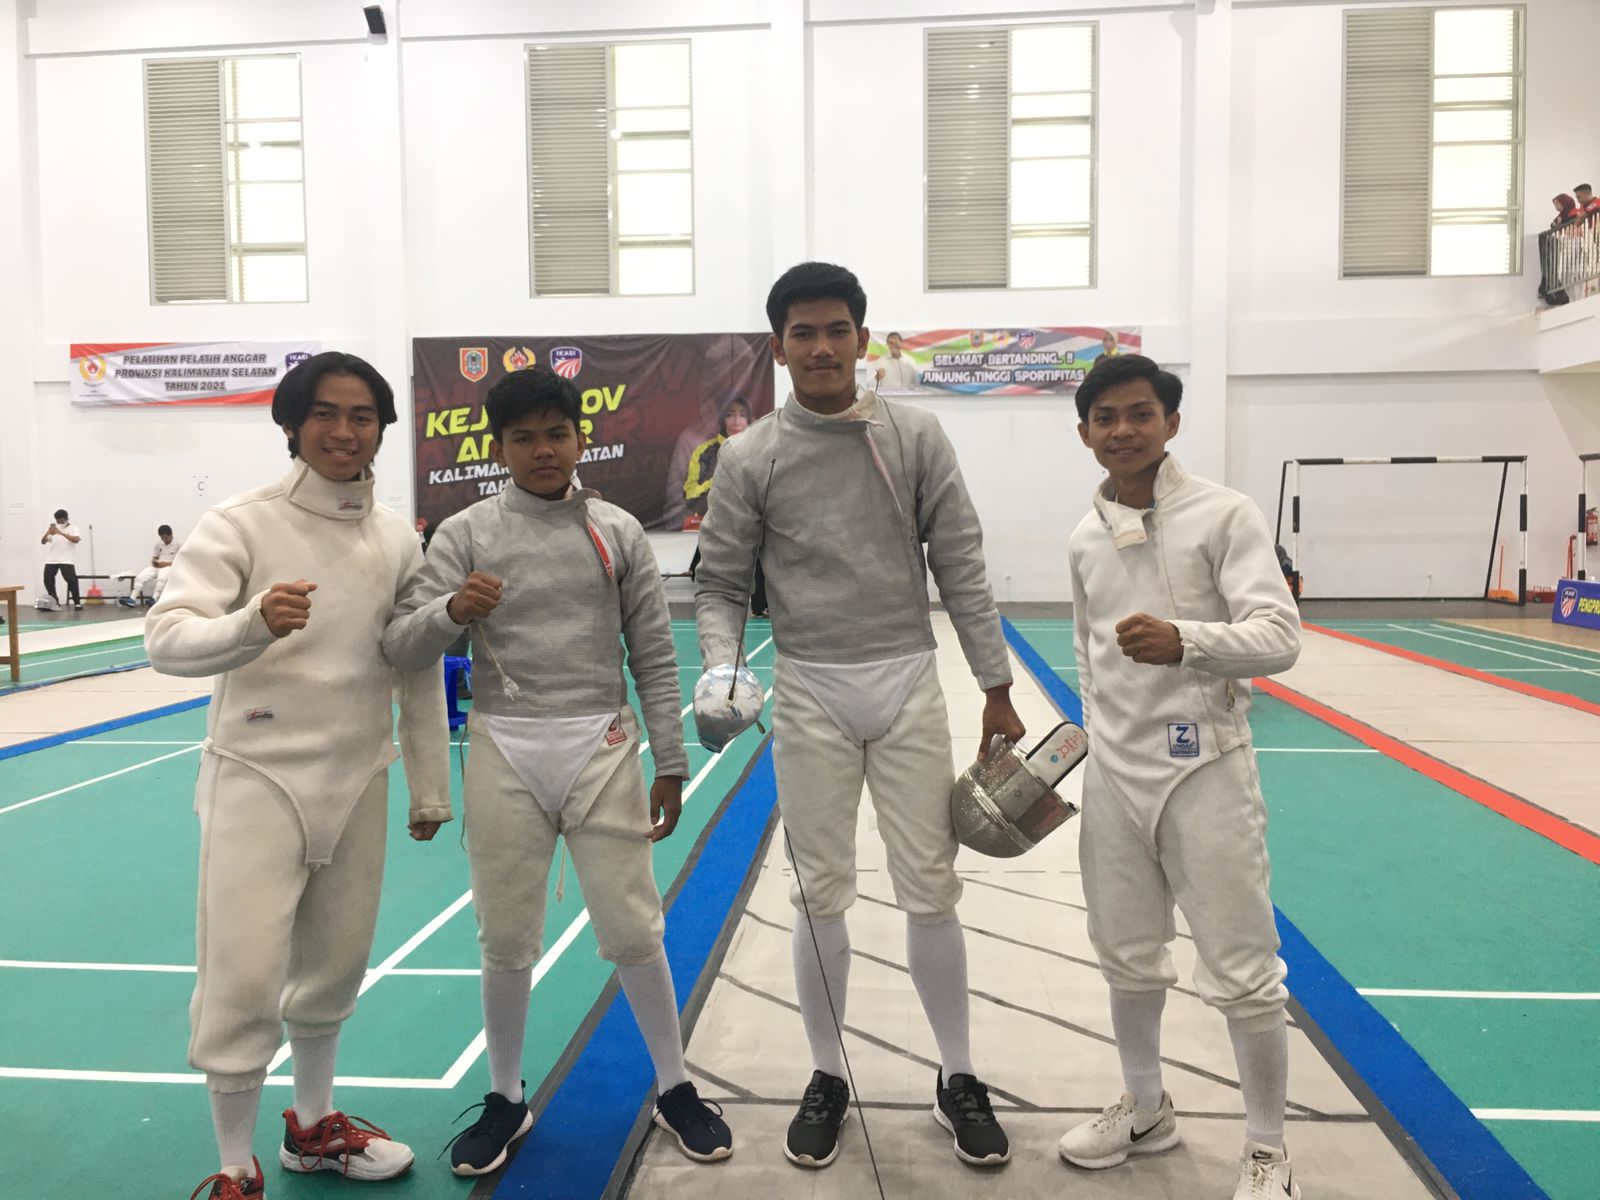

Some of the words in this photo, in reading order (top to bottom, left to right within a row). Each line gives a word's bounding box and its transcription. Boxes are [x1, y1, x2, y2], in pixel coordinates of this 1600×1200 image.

[123, 354, 178, 365] PELATIHAN
[180, 353, 221, 365] PELATIH
[222, 353, 267, 364] ANGGAR
[935, 354, 983, 365] SELAMAT
[114, 367, 162, 379] PROVINSI
[164, 367, 229, 378] KALIMANTAN
[231, 367, 277, 377] SELATAN
[923, 371, 971, 384] JUNJUNG
[974, 370, 1011, 383] TINGGI
[1014, 369, 1085, 382] SPORTIFITAS
[164, 381, 198, 392] TAHUN
